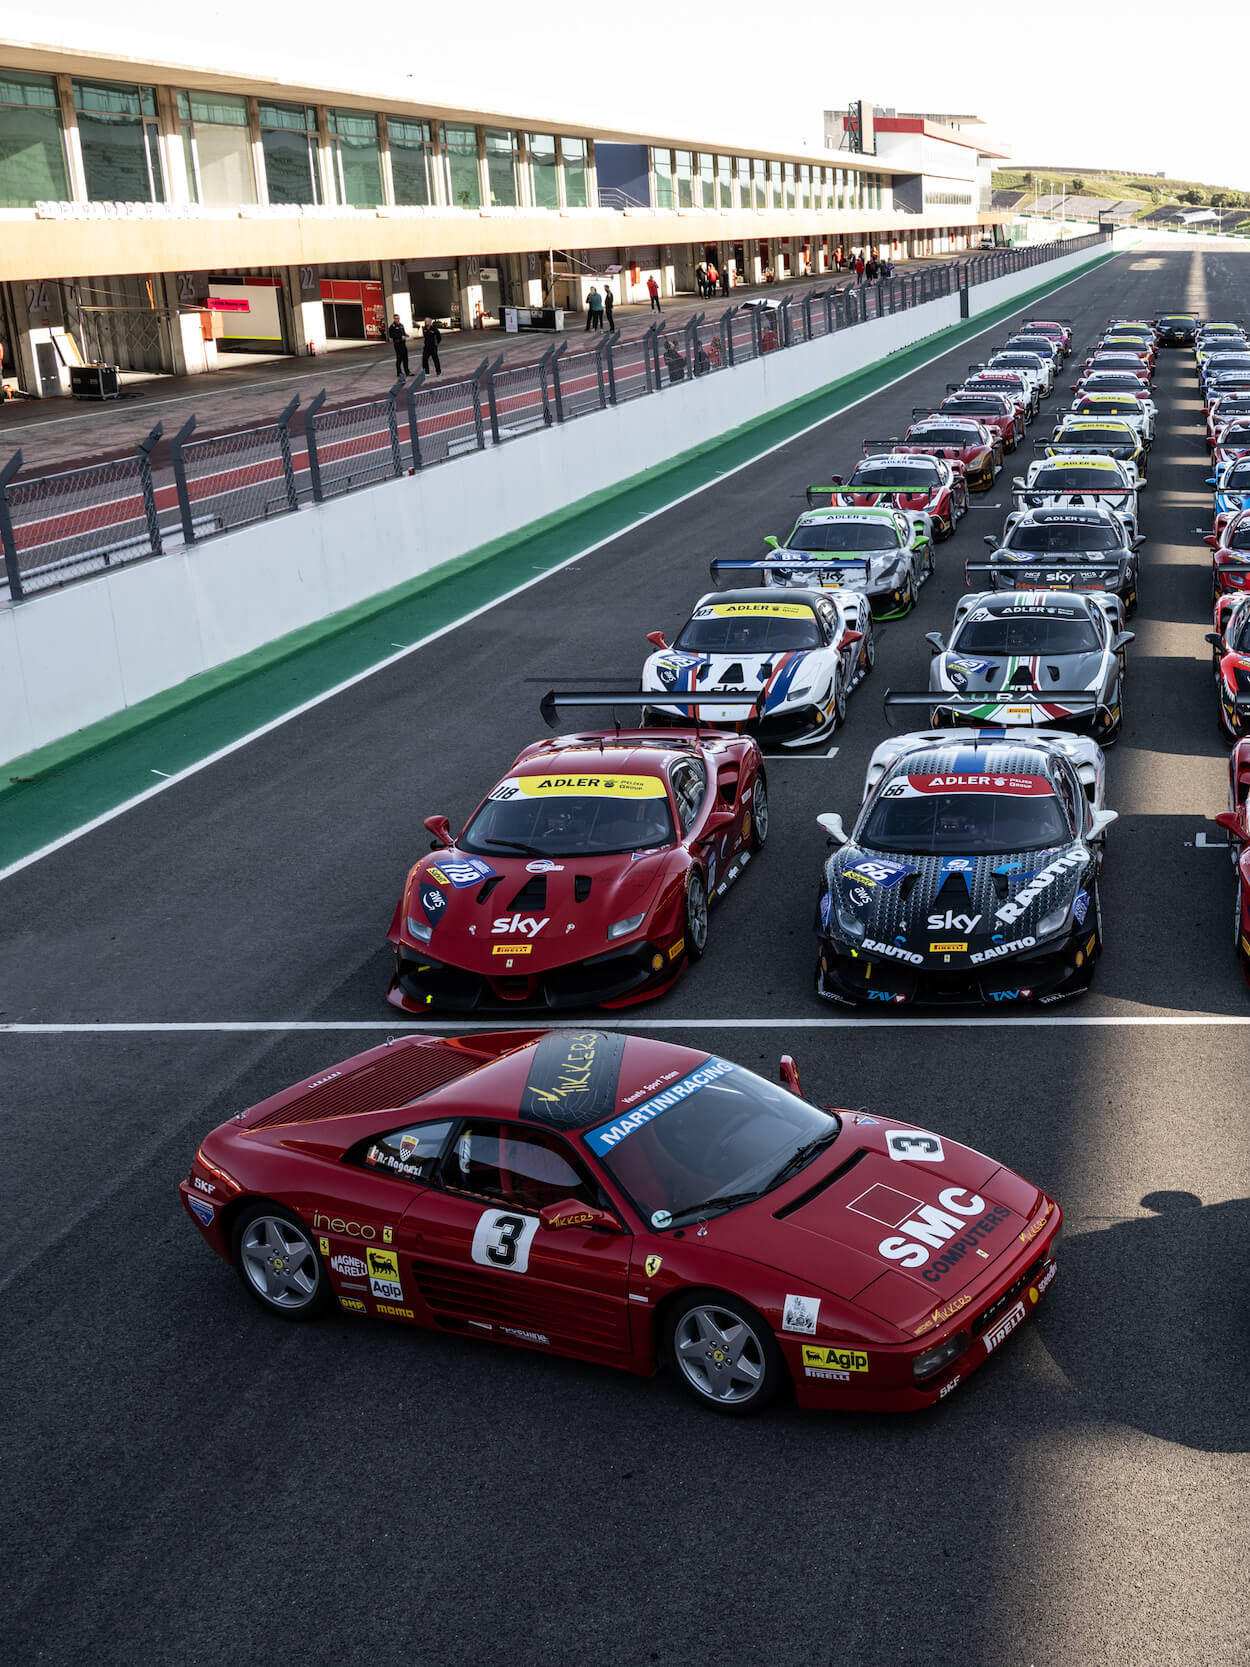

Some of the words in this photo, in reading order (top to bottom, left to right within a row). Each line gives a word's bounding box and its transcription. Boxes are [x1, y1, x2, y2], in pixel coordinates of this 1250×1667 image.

[178, 273, 196, 300] 23
[301, 267, 315, 289] 22
[26, 283, 51, 313] 24
[817, 572, 844, 582] sky
[1046, 571, 1075, 583] sky
[726, 604, 769, 612] ADLER
[537, 778, 600, 789] ADLER
[884, 784, 908, 796] 66
[928, 776, 990, 786] ADLER
[491, 786, 519, 799] 118
[440, 863, 481, 883] 118
[855, 862, 897, 881] 66
[854, 887, 872, 904] aws
[994, 849, 1090, 924] RAUTIO
[428, 890, 446, 908] aws
[491, 913, 551, 938] sky
[927, 909, 983, 935] sky
[861, 937, 924, 964] RAUTIO
[969, 936, 1036, 964] RAUTIO
[622, 1089, 645, 1104] Veneto
[644, 1079, 662, 1094] Sport
[661, 1070, 680, 1081] Team
[600, 1092, 679, 1146] MARTINI
[673, 1061, 734, 1097] RACING
[891, 1136, 940, 1153] 3
[194, 1177, 216, 1195] SKF
[313, 1209, 376, 1239] ineco
[878, 1187, 986, 1268] SMC
[486, 1214, 526, 1267] 3
[922, 1205, 1011, 1283] COMPUTERS
[373, 1280, 402, 1298] Agip
[341, 1298, 364, 1310] OMP
[376, 1304, 415, 1318] momo
[982, 1300, 1026, 1354] PIRELLI
[825, 1349, 867, 1369] Agip
[805, 1367, 850, 1381] PIRELLI
[939, 1375, 960, 1398] SKF
